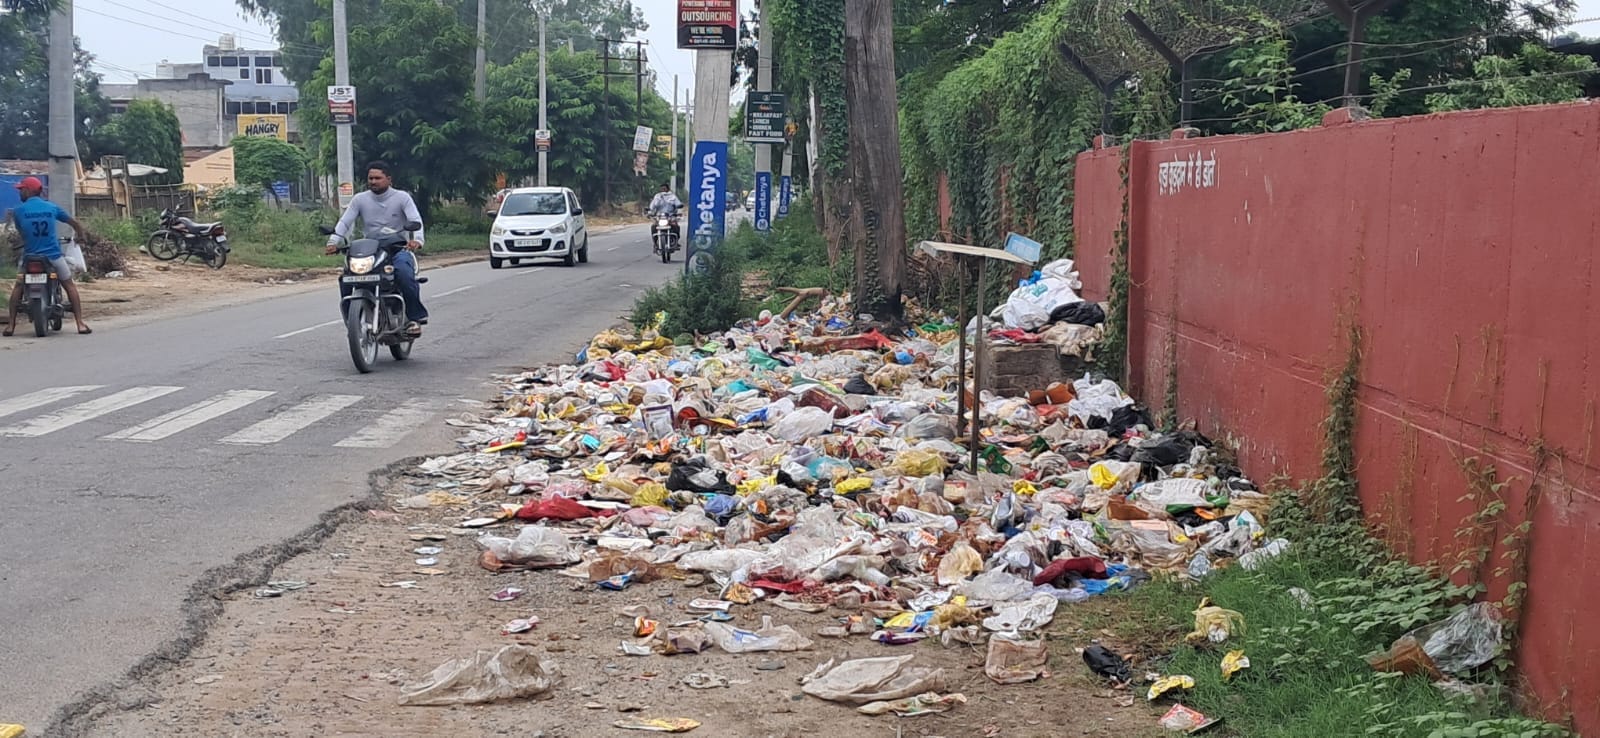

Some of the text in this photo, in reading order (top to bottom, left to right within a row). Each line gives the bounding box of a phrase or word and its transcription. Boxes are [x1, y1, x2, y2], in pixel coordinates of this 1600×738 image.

[681, 11, 732, 22] OUTSOURCING
[245, 122, 280, 136] HANGRY
[1187, 151, 1195, 187] में
[1195, 149, 1202, 189] ही
[695, 152, 721, 250] Chetanya
[758, 175, 769, 218] Chetanya
[31, 220, 49, 237] 32
